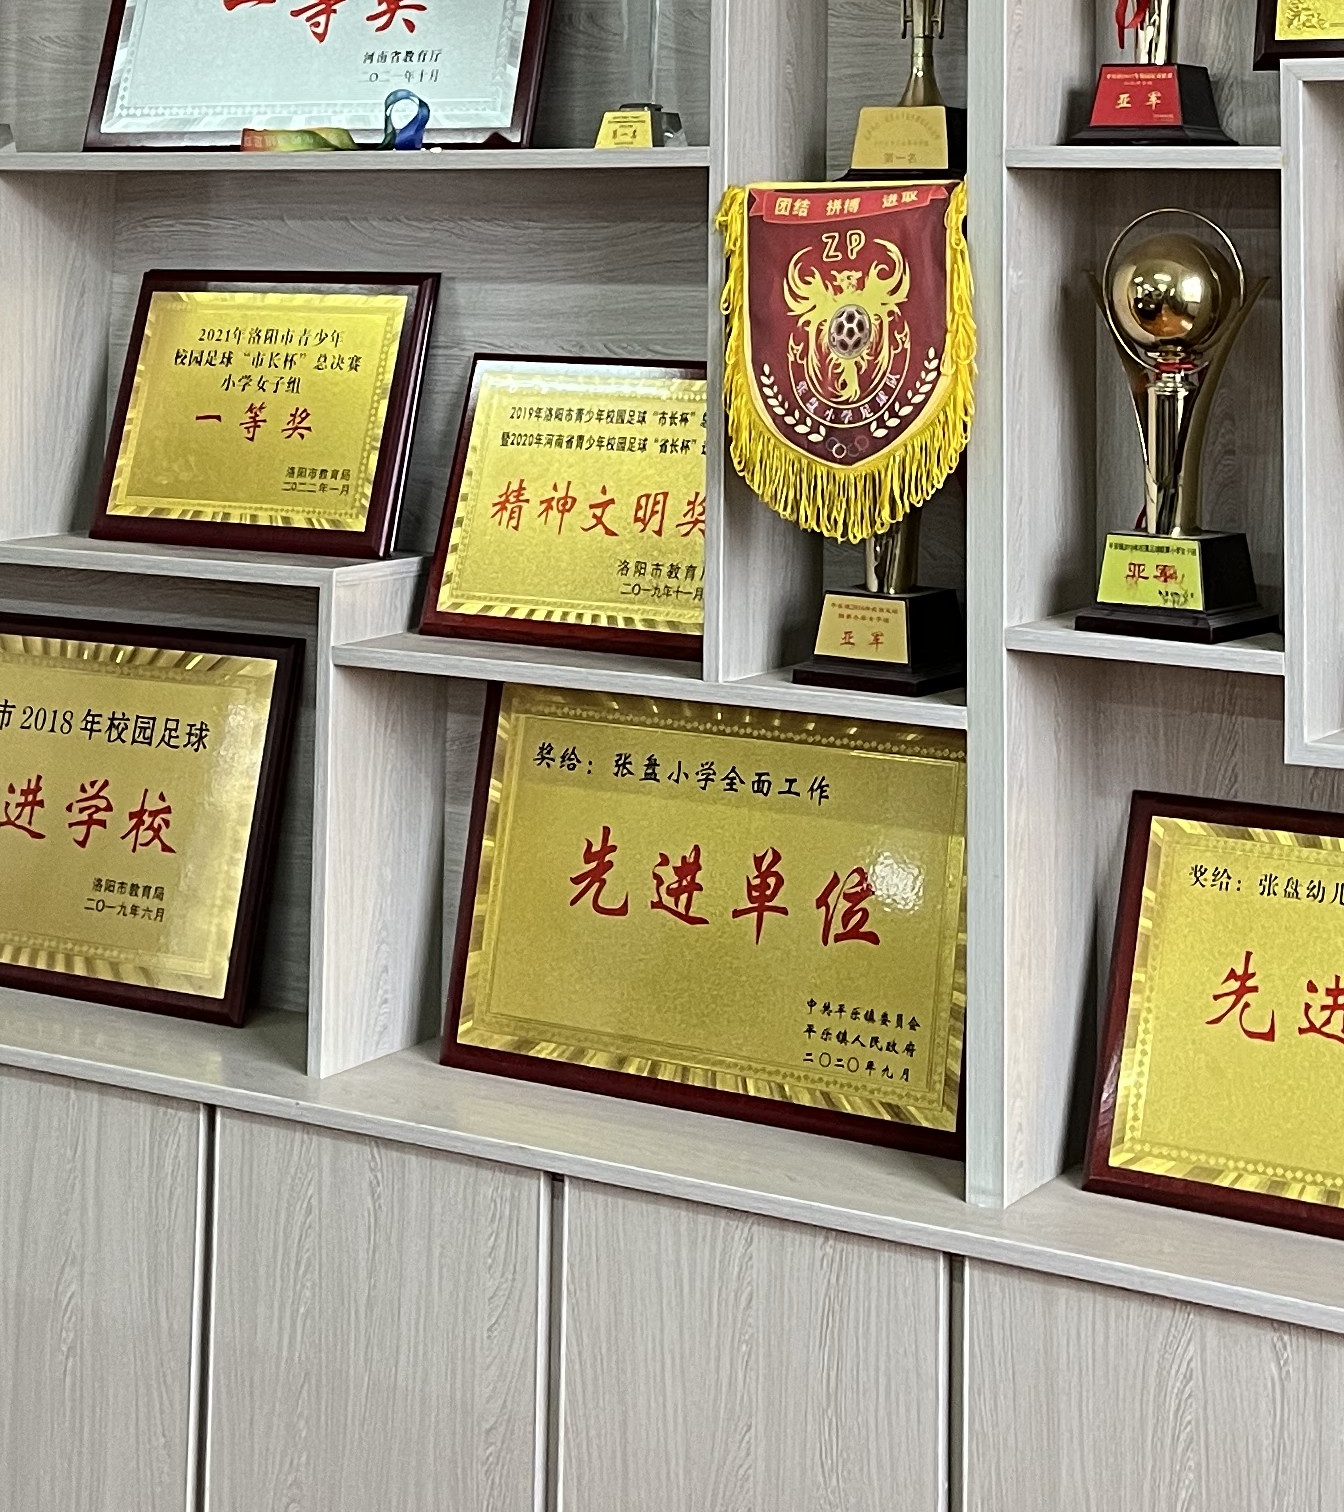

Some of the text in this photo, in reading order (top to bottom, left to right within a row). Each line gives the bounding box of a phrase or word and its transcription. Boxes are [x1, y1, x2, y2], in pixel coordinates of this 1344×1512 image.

[363, 48, 443, 65] 河南省教育厅
[1115, 91, 1162, 110] 亚军
[774, 190, 919, 217] 团结 拼搏 进取
[198, 327, 344, 347] 2021年洛阳市青少年
[221, 374, 302, 395] 小学女子组
[195, 401, 312, 442] 一等奖
[285, 466, 351, 481] 洛阳市教育局
[490, 478, 707, 538] 精神文明奖
[617, 559, 706, 582] 洛阳市教育
[1125, 562, 1178, 583] 亚军
[840, 631, 884, 652] 亚军
[532, 742, 831, 806] 奖给：张盘小学全面工作
[92, 877, 166, 902] 洛阳市教育局
[569, 825, 882, 947] 先进单位
[803, 1023, 917, 1059] 平乐镇人民政府
